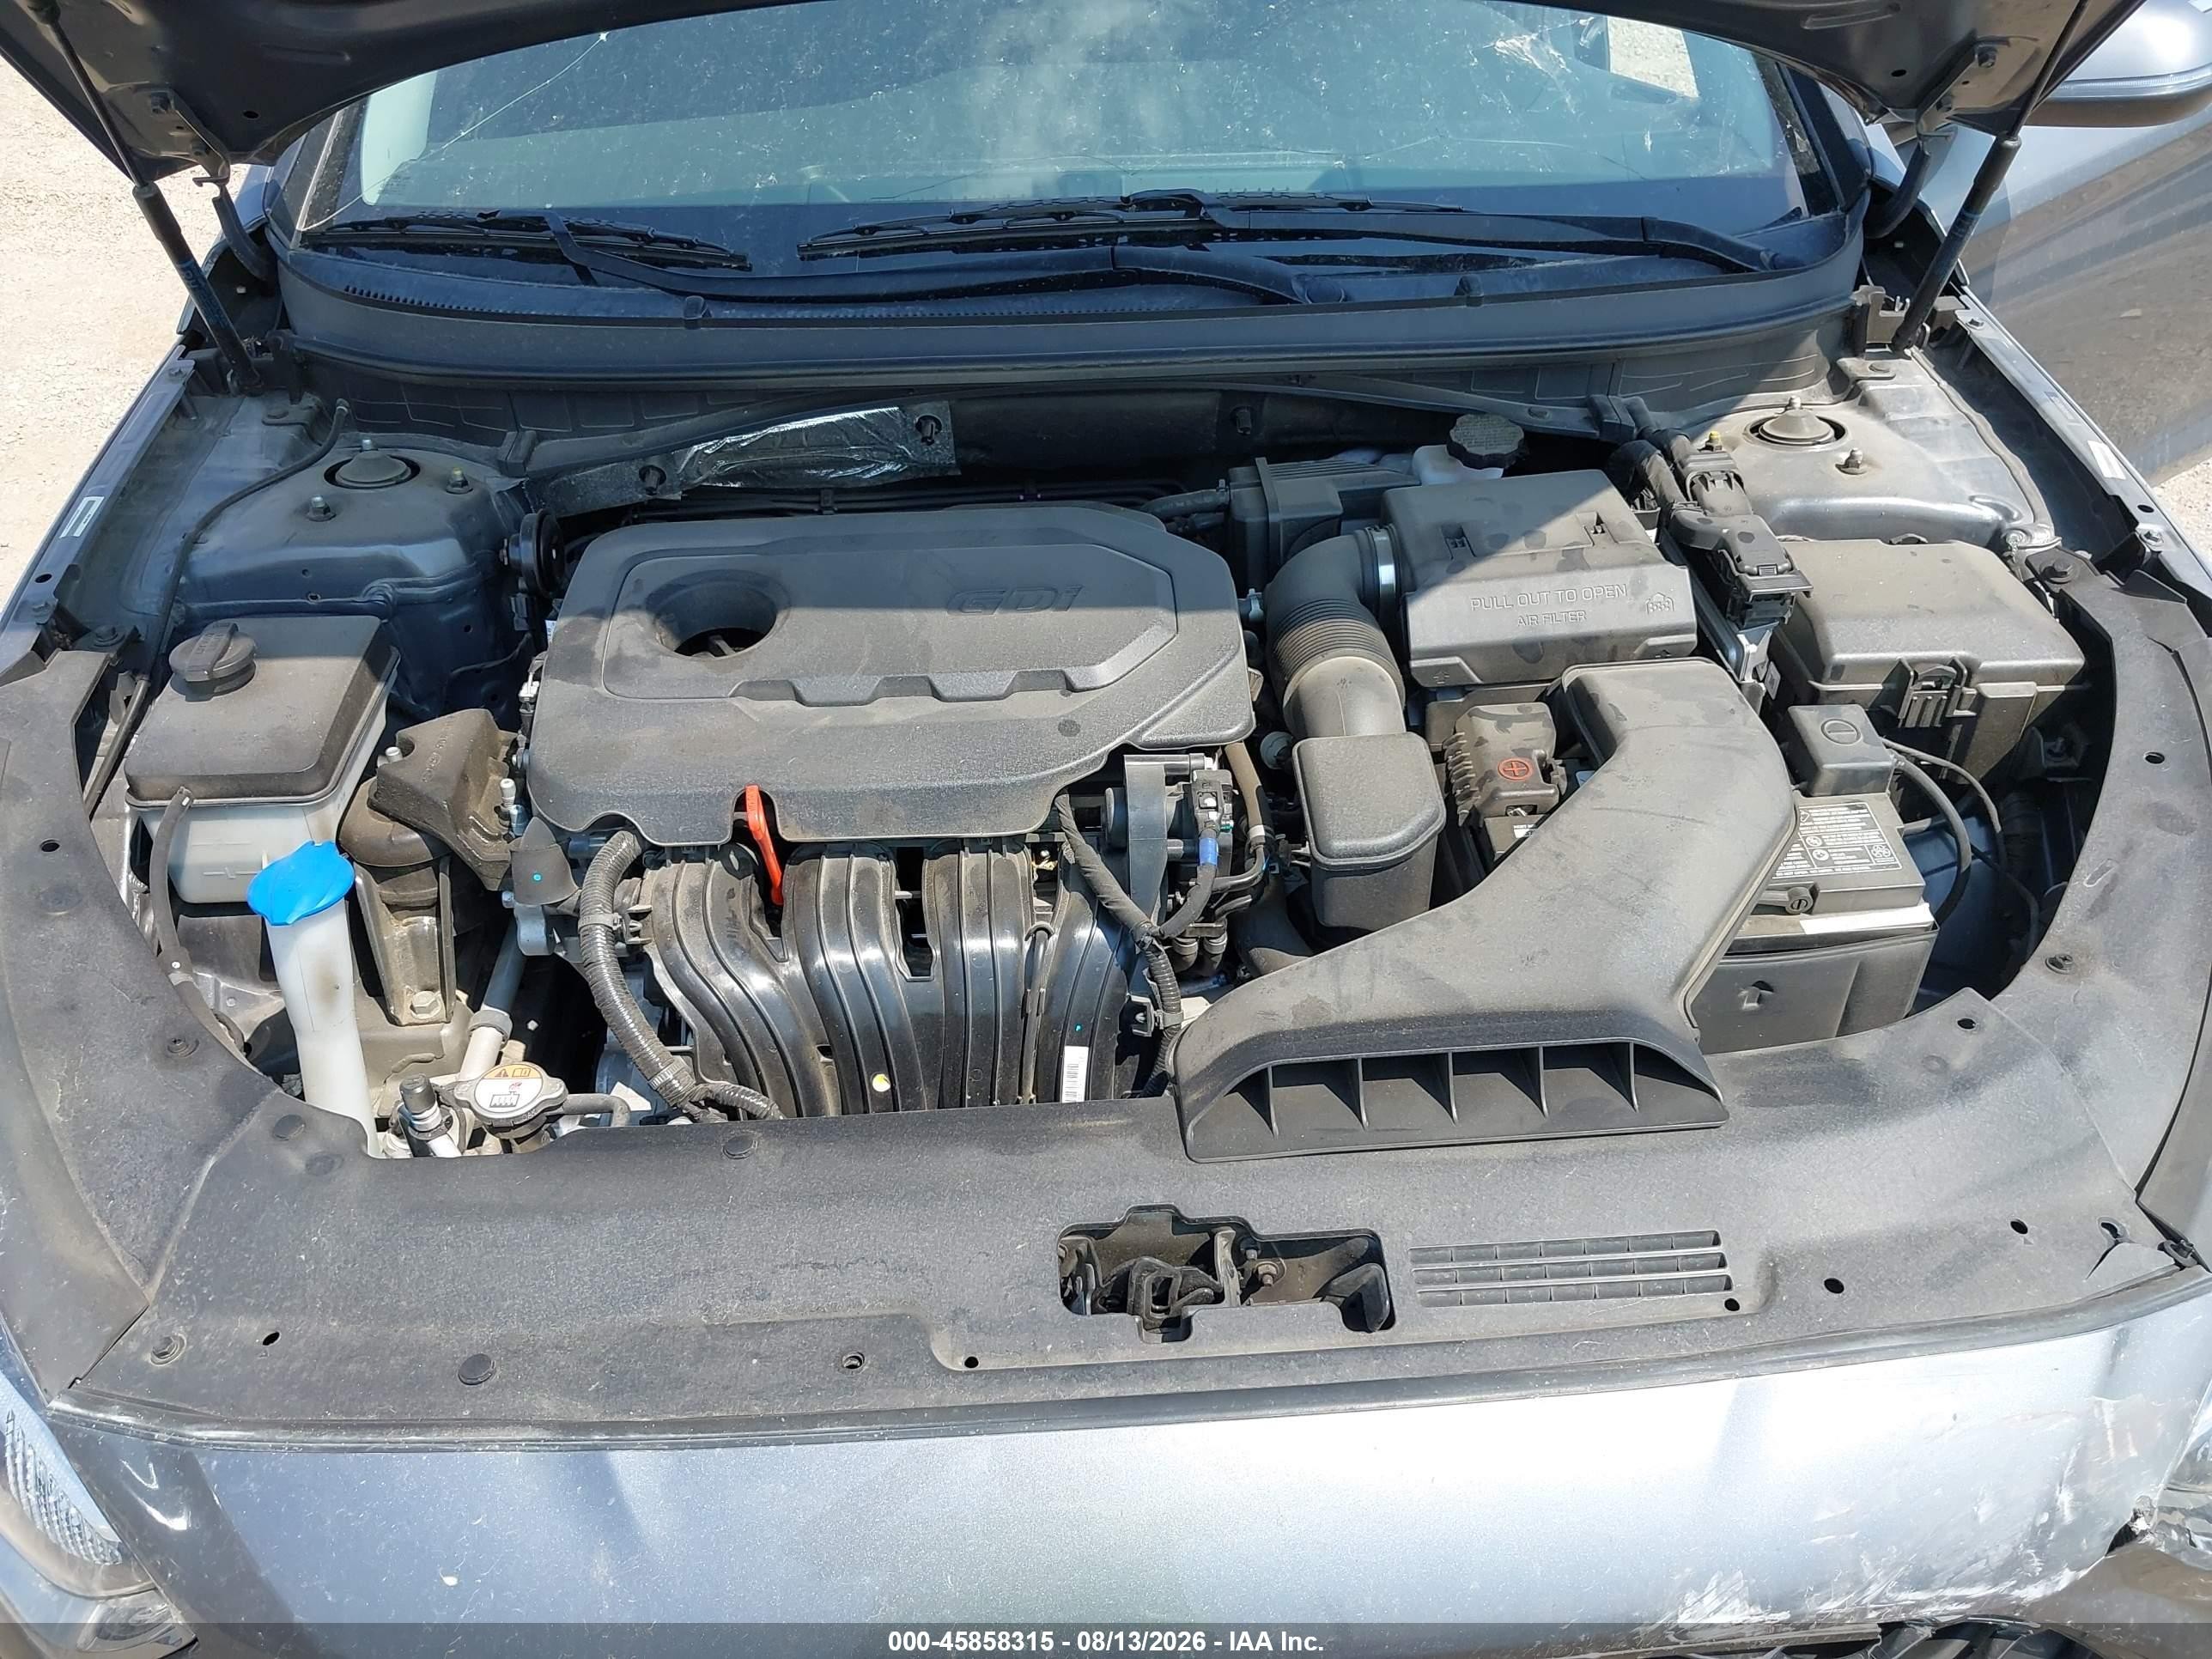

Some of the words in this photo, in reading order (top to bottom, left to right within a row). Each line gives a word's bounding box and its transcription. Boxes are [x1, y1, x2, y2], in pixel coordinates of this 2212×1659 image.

[1470, 595, 1514, 611] PULL
[1517, 591, 1551, 605] OUT
[1554, 588, 1577, 603] TO
[1582, 583, 1628, 600] OPEN
[1517, 614, 1539, 627] AIR
[1541, 610, 1588, 625] FILTER
